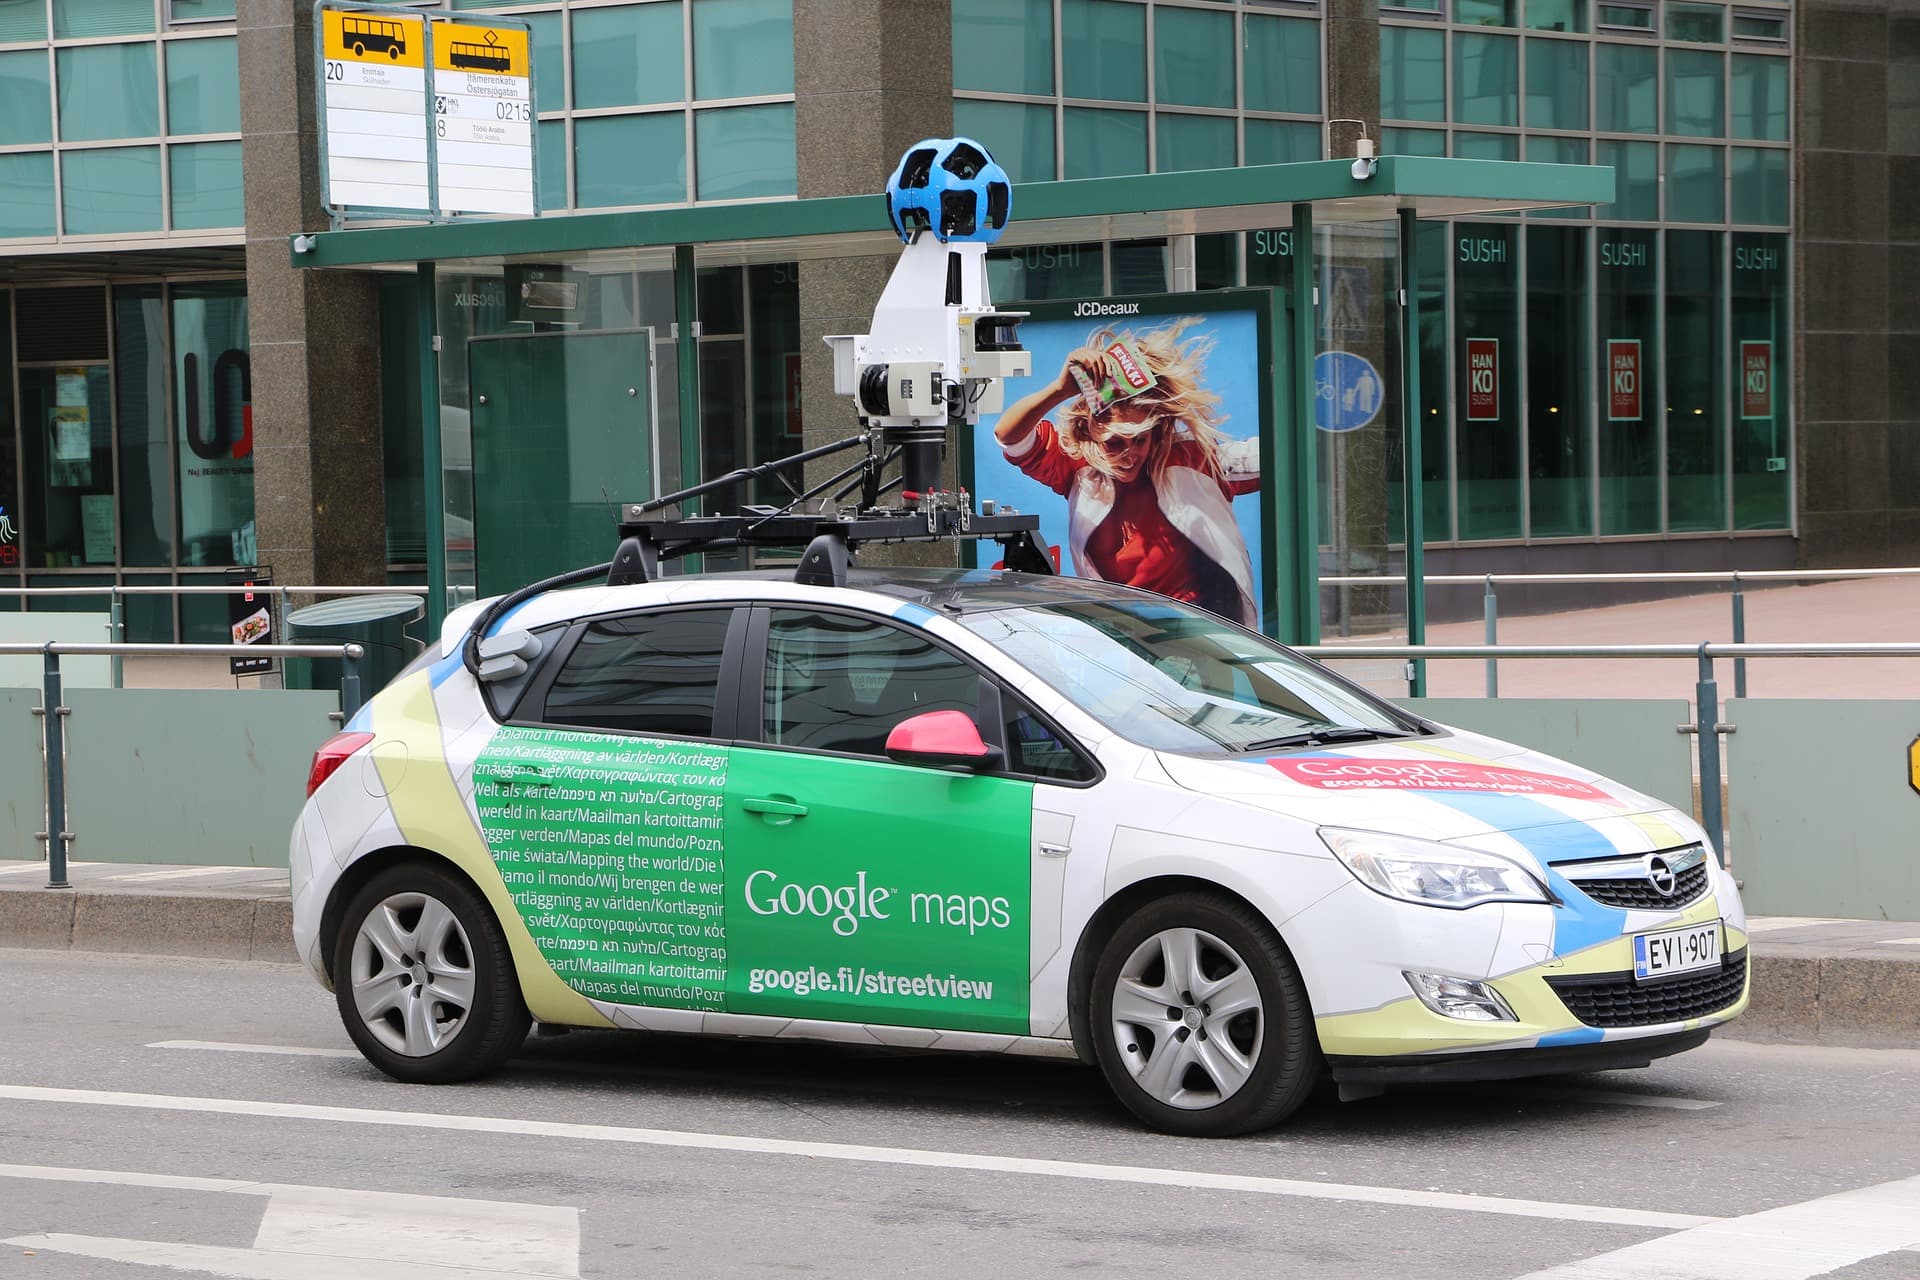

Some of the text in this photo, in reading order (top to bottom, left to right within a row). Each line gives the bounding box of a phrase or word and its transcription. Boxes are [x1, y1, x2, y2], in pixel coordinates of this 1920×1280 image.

[327, 62, 343, 81] 20
[496, 102, 531, 121] 0215
[437, 119, 446, 137] 8
[1010, 244, 1080, 271] SUSHI
[1460, 238, 1506, 262] SUSHI
[1602, 243, 1646, 266] SUSHI
[1736, 247, 1777, 270] SUSHI
[1074, 301, 1140, 317] JCDecaux
[1109, 345, 1145, 386] JENKKI
[1472, 354, 1493, 368] HAN
[1615, 354, 1634, 368] HAN
[1747, 354, 1766, 368] HAN
[1472, 370, 1493, 393] KO
[1615, 370, 1634, 393] KO
[1747, 370, 1766, 393] KO
[597, 752, 613, 762] av
[1297, 762, 1593, 794] Google maps
[503, 784, 521, 798] als
[480, 804, 521, 820] wereld
[526, 805, 536, 820] in
[541, 806, 641, 825] kaart/Maailman
[520, 827, 611, 849] verden/Mapas
[614, 831, 633, 847] del
[637, 833, 723, 851] mundo/Pozn
[491, 847, 520, 862] anie
[524, 847, 624, 872] świata/Mapping
[628, 852, 649, 869] the
[652, 855, 716, 873] world/Die
[538, 869, 545, 885] il
[549, 872, 618, 893] mondo/Wij
[622, 874, 676, 896] brengen
[679, 878, 696, 893] de
[585, 897, 600, 909] av
[745, 870, 890, 936] Google
[911, 892, 1010, 935] maps
[1650, 930, 1715, 969] EVI-907
[547, 957, 646, 977] aart/Maailman
[620, 980, 640, 996] del
[748, 966, 993, 1000] google.fi/streetview
